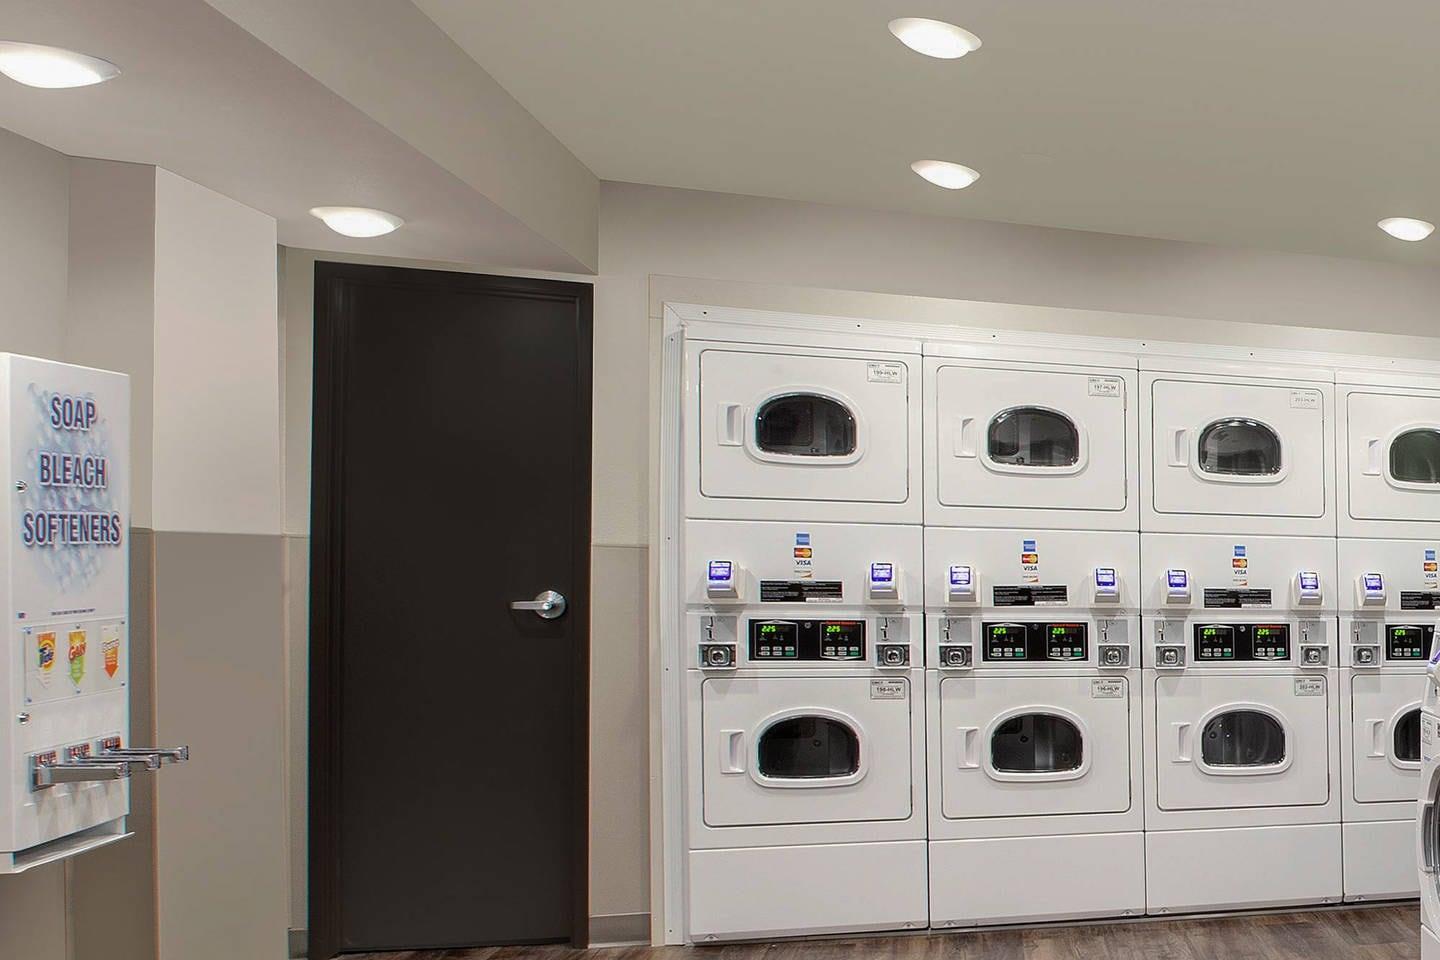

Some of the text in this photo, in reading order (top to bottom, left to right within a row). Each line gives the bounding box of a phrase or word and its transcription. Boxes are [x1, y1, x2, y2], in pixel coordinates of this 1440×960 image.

[51, 395, 97, 430] SOAP
[40, 452, 107, 487] BLEACH
[22, 511, 122, 544] SOFTENERS
